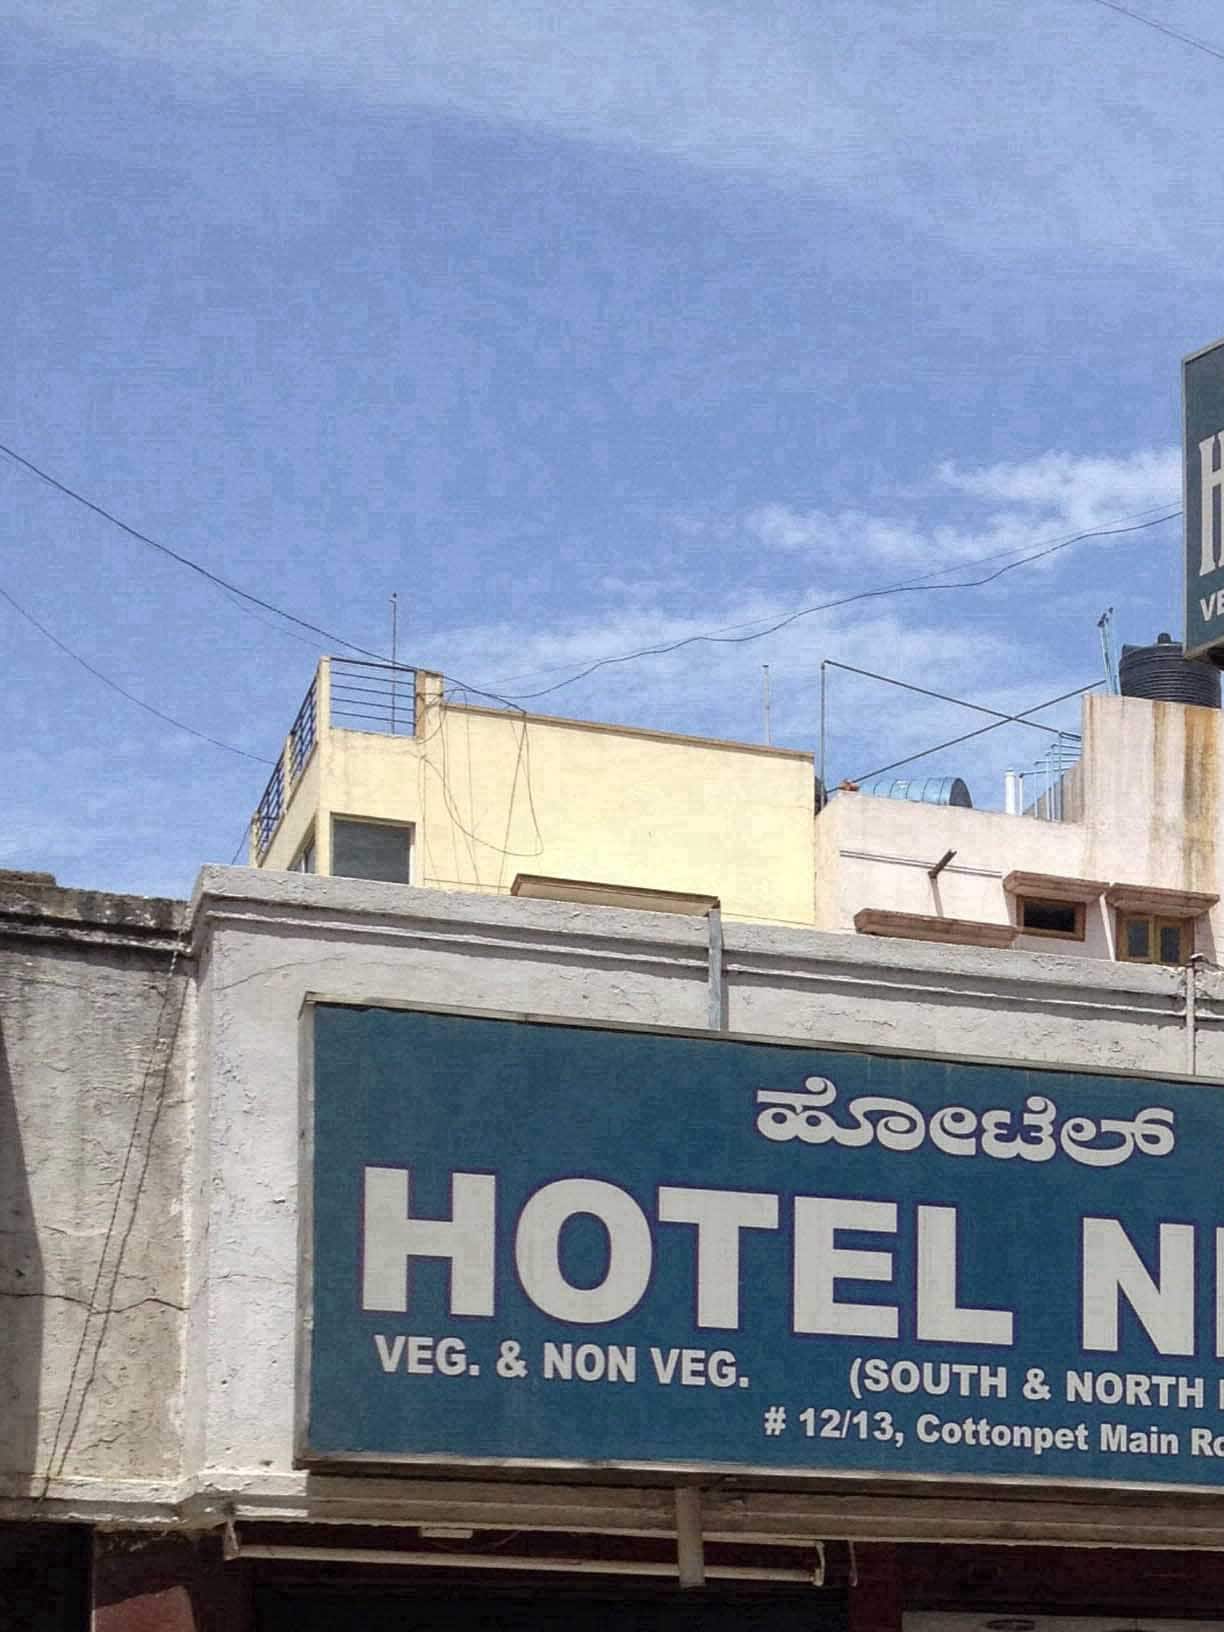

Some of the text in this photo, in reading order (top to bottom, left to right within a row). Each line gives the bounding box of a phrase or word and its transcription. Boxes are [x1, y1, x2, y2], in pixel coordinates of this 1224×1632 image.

[756, 1076, 1175, 1167] ಹೋಟೆಲ್
[362, 1165, 1013, 1346] HOTEL
[374, 1335, 750, 1389] VEG. & NON VEG.
[849, 1358, 1008, 1400] (SOUTH
[1022, 1368, 1051, 1401] &
[1066, 1371, 1204, 1410] NORTH
[764, 1407, 786, 1435] #
[798, 1408, 905, 1448] 12/13,
[916, 1413, 1089, 1454] Cottonpet
[1101, 1423, 1179, 1456] Main
